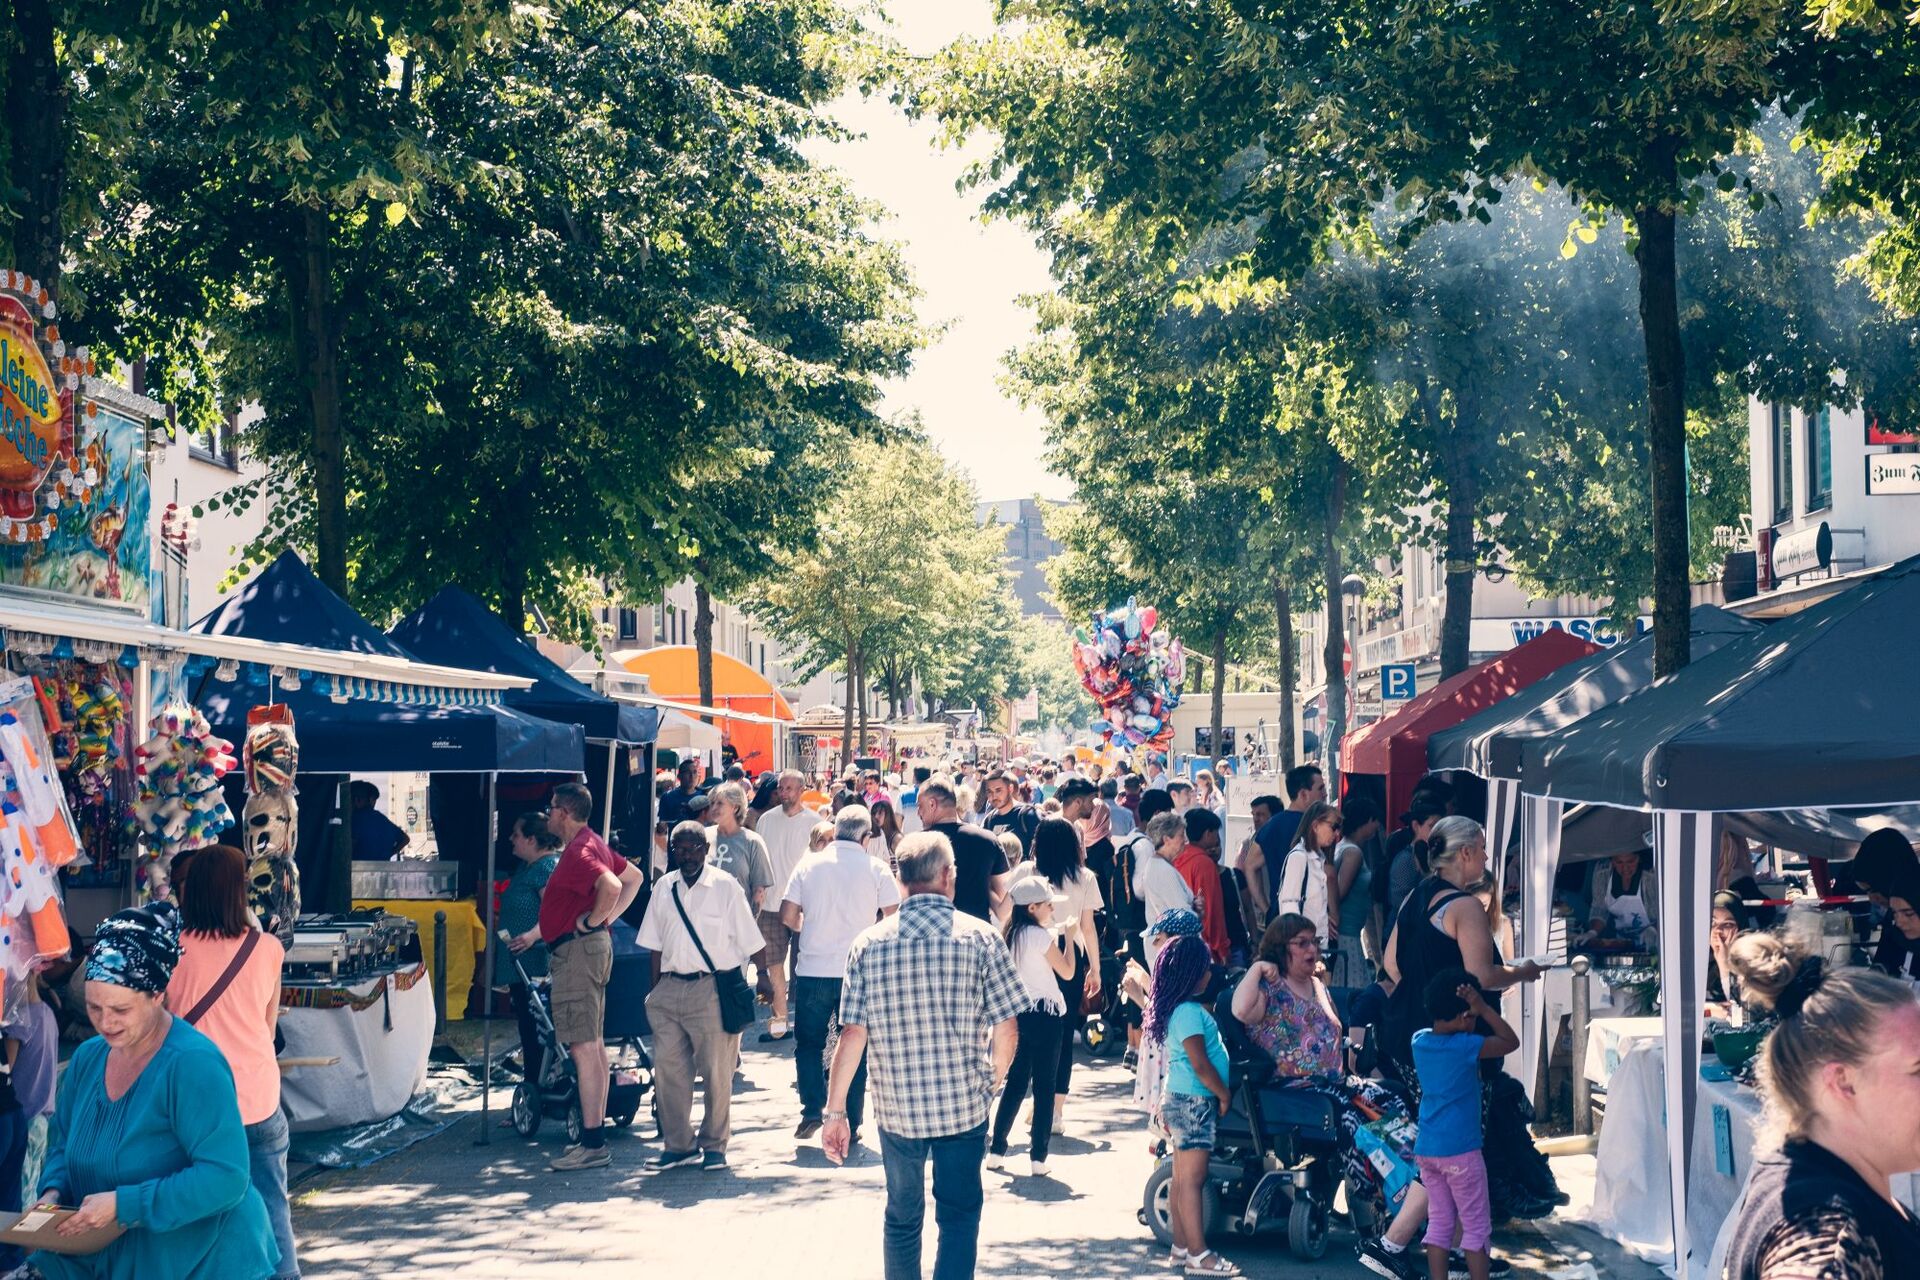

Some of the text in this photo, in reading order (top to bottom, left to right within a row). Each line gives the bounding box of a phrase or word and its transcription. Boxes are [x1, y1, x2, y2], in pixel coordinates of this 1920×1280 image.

[0, 339, 48, 418] leine
[0, 388, 48, 471] ische
[1389, 669, 1408, 695] P
